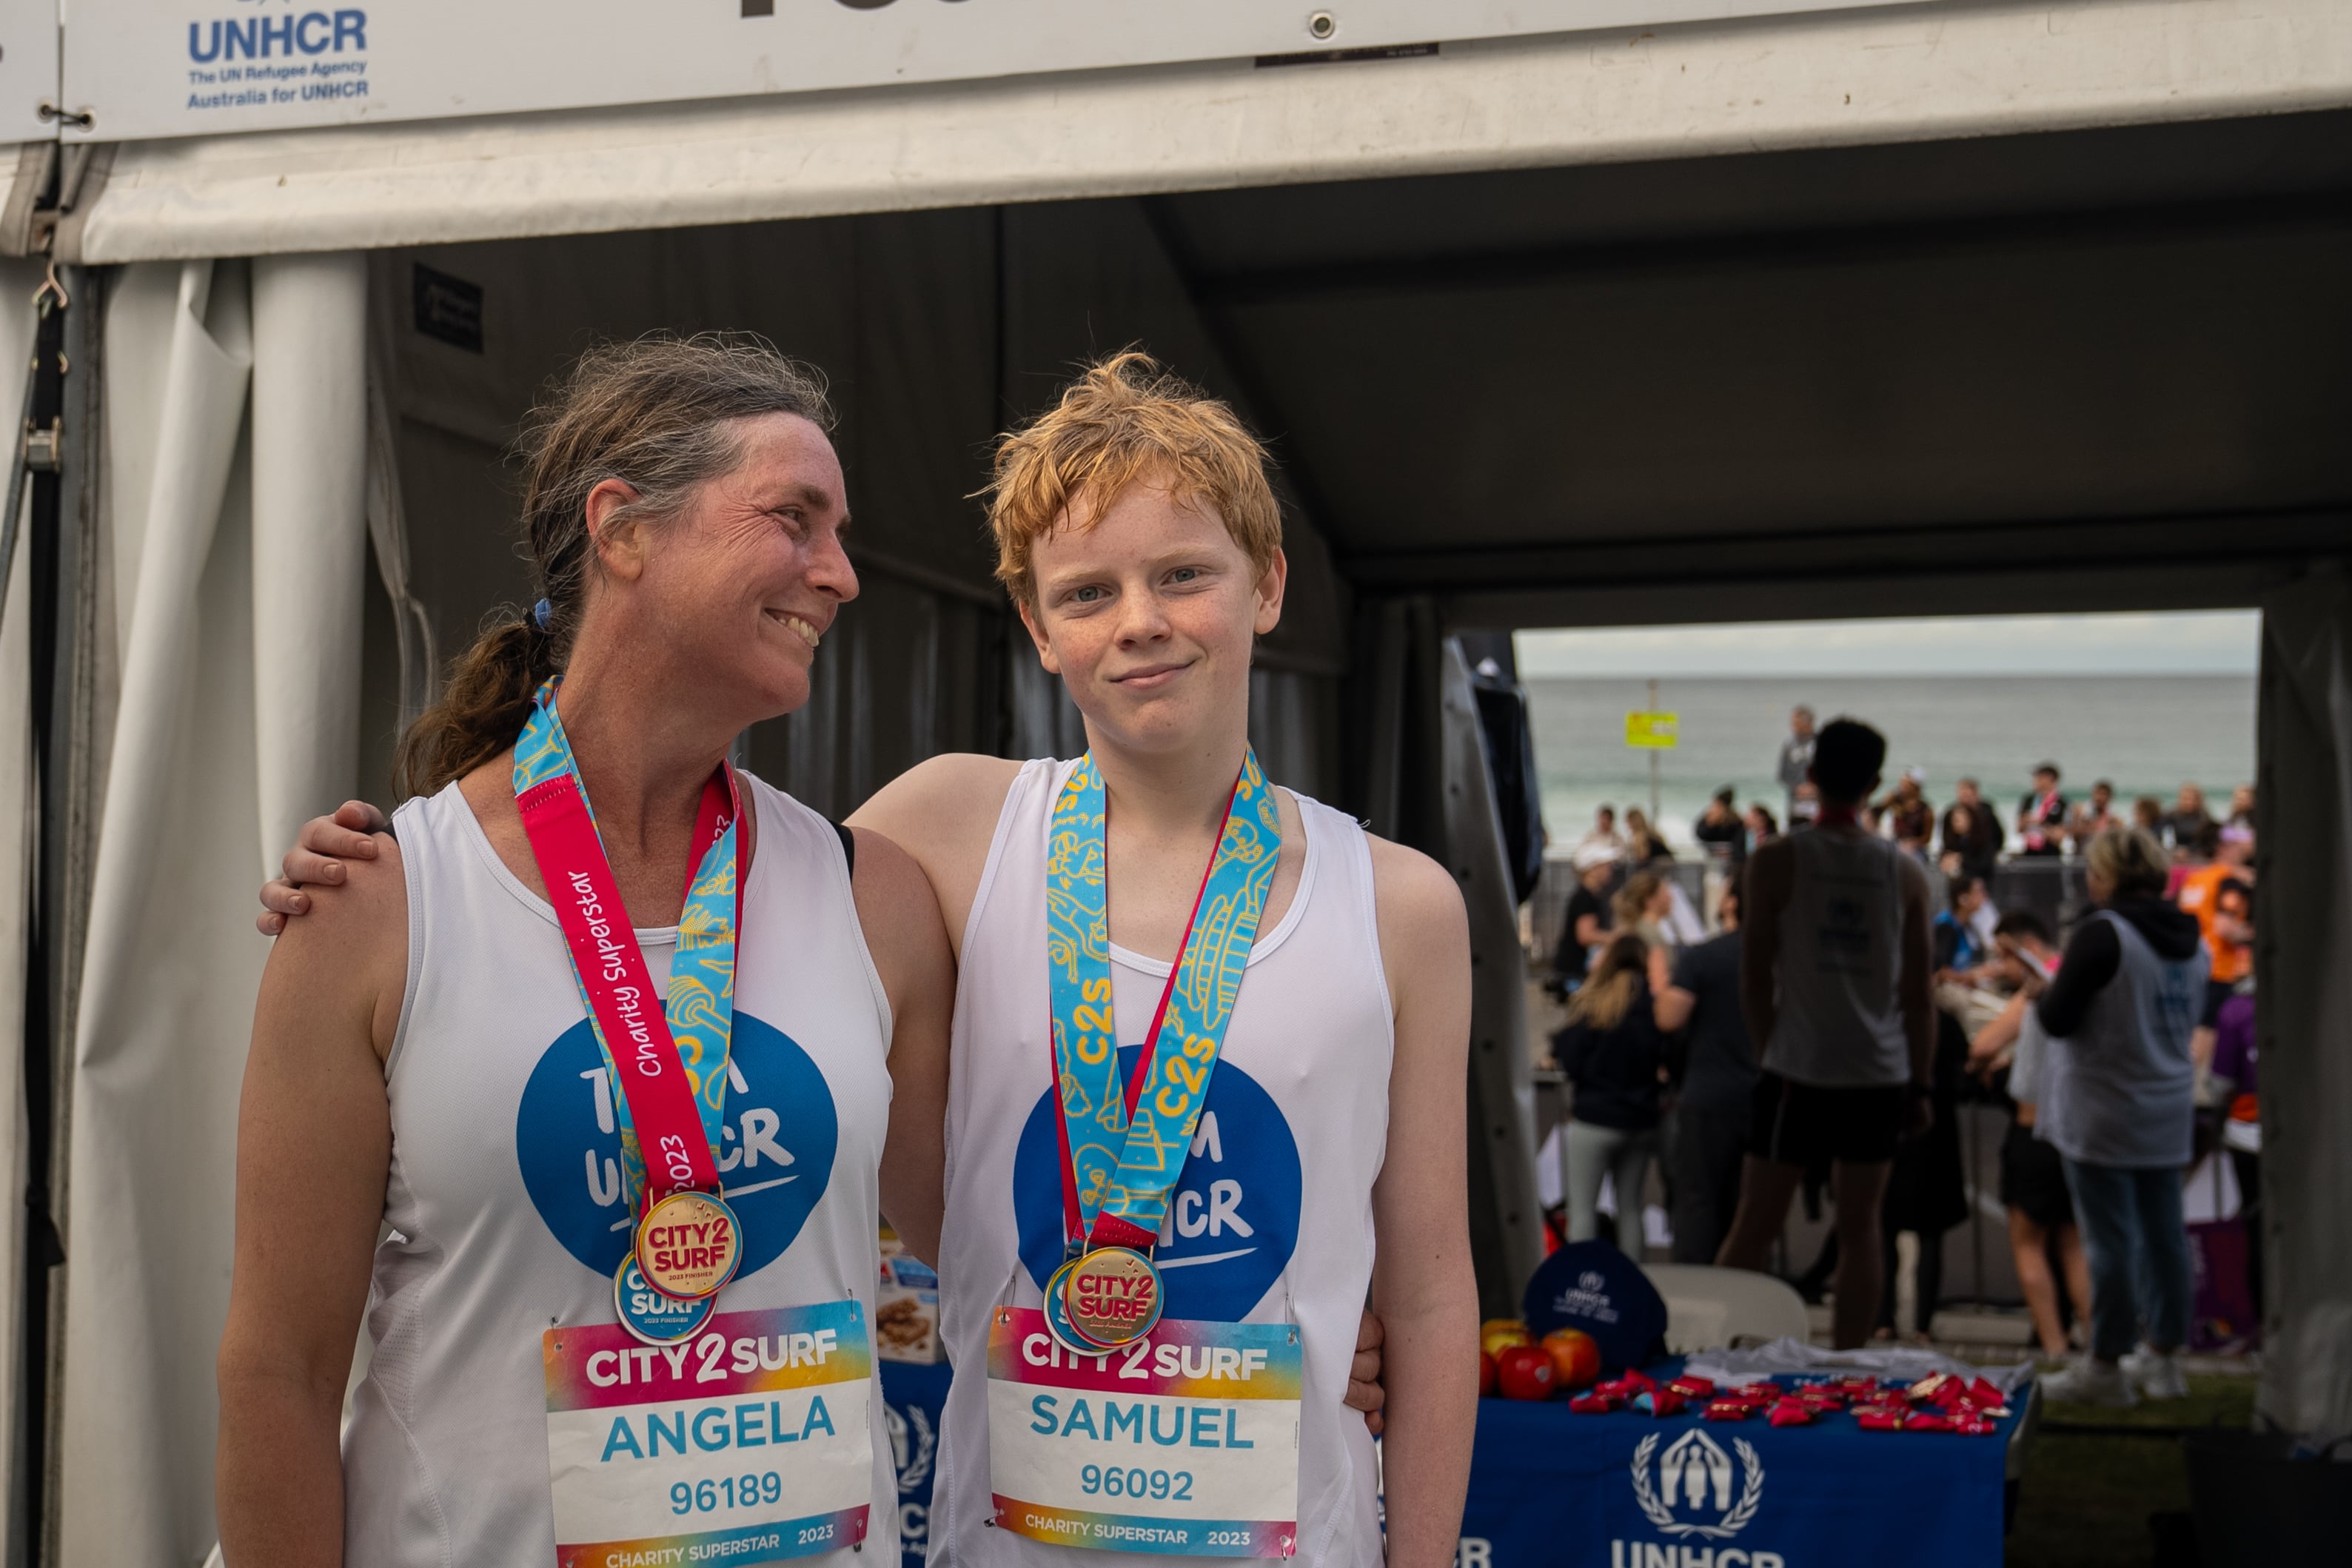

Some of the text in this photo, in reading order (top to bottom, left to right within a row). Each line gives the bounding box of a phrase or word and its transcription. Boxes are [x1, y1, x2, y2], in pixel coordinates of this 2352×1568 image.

[190, 10, 366, 63] UNHCR
[190, 61, 368, 84] The UN Refugee Agency
[188, 81, 368, 109] Australia for UNHCR
[613, 986, 662, 1077] Charity
[648, 1217, 730, 1250] CITY2
[654, 1244, 726, 1273] SURF
[1076, 1273, 1154, 1301] CITY2
[1078, 1296, 1147, 1321] SURF
[600, 1394, 836, 1464] ANGELA
[1030, 1394, 1254, 1450] SAMUEL
[669, 1471, 782, 1515] 96189
[1080, 1464, 1194, 1502] 96092
[606, 1524, 834, 1568] CHARITY SUPERSTAR 2023
[1025, 1514, 1251, 1547] CHARITY SUPERSTAR 2023
